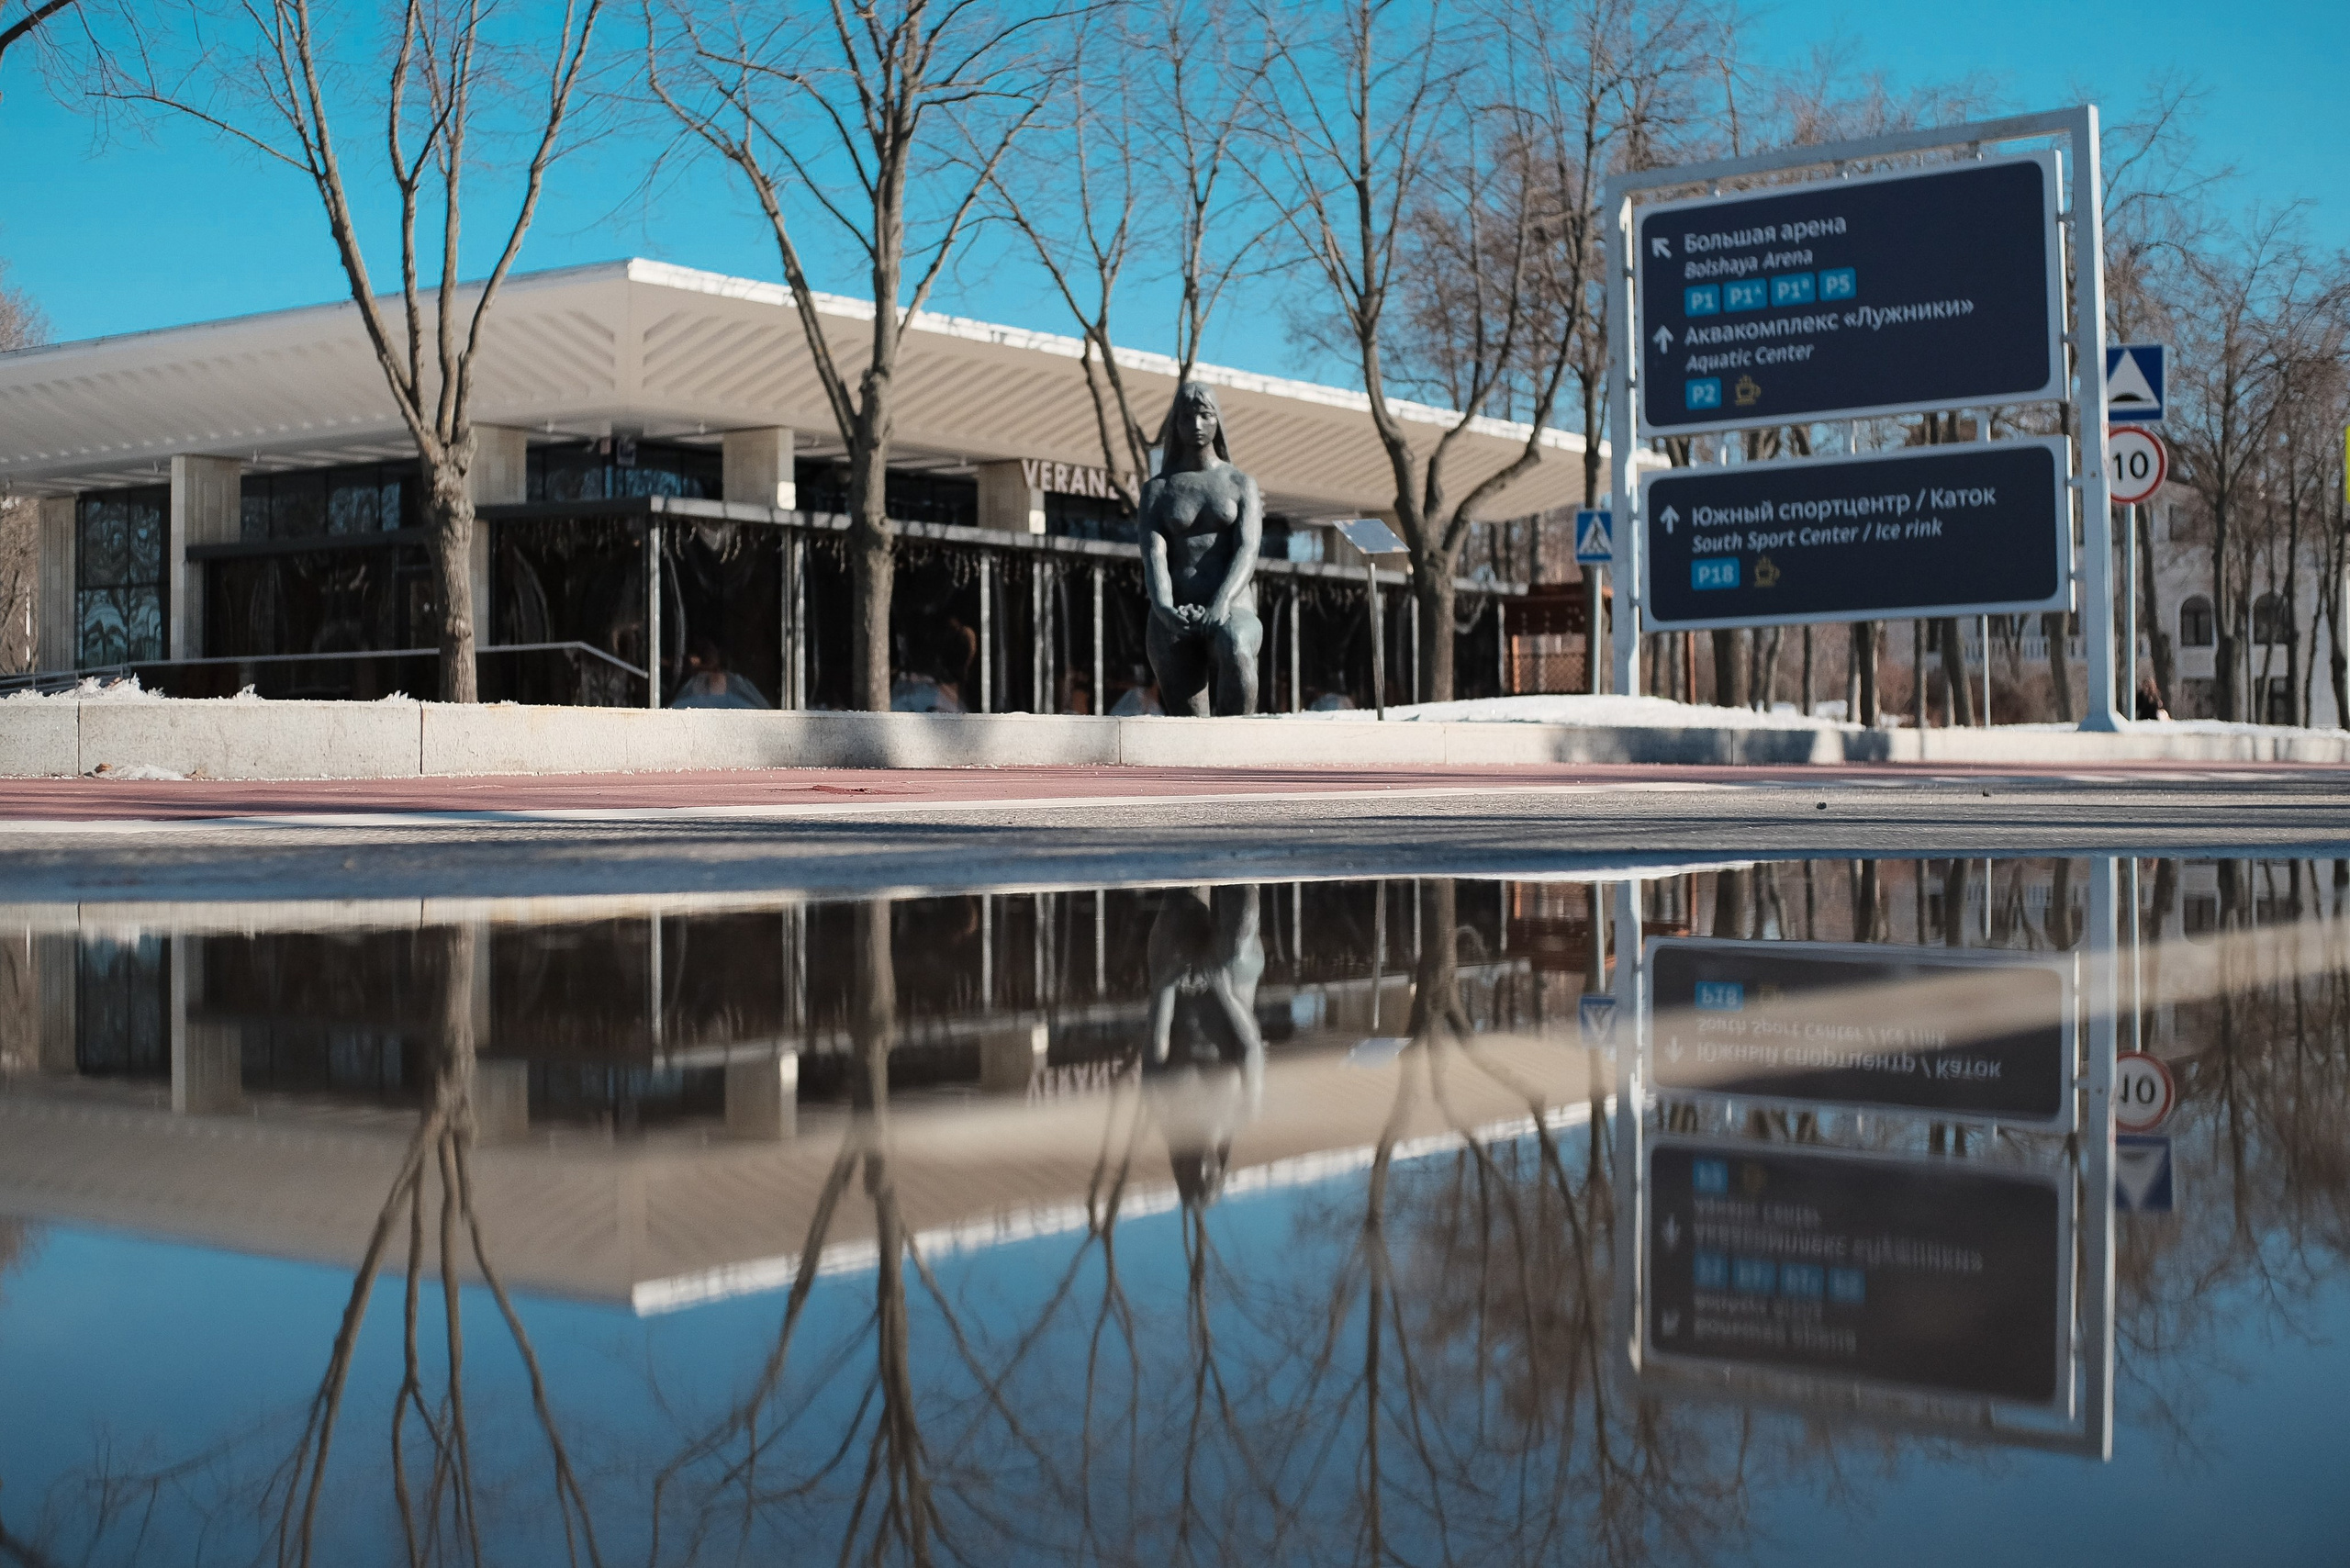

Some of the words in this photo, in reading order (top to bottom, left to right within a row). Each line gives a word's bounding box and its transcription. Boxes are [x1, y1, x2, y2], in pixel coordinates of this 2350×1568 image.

[1684, 225, 1776, 254] Большая
[1781, 217, 1847, 244] арена
[1684, 255, 1759, 279] Bolshaya
[1762, 249, 1813, 270] Arena
[1691, 292, 1714, 309] P1
[1826, 274, 1851, 295] P5
[1684, 312, 1840, 346] Аквакомплекс
[1843, 298, 1974, 331] «Лужники»
[1685, 348, 1751, 374] Aquatic
[1754, 343, 1815, 365] Center
[1692, 384, 1716, 403] P2
[2112, 450, 2149, 481] 10
[1692, 500, 1774, 527] Южный
[1778, 493, 1910, 522] спортцентр
[1915, 487, 1926, 511] /
[1930, 487, 1997, 510] Каток
[1692, 532, 1742, 554] South
[1747, 529, 1796, 554] Sport
[1799, 525, 1859, 546] Center
[1862, 522, 1872, 543] /
[1875, 522, 1900, 541] Ice
[1905, 517, 1943, 538] rink
[1698, 565, 1735, 584] P18
